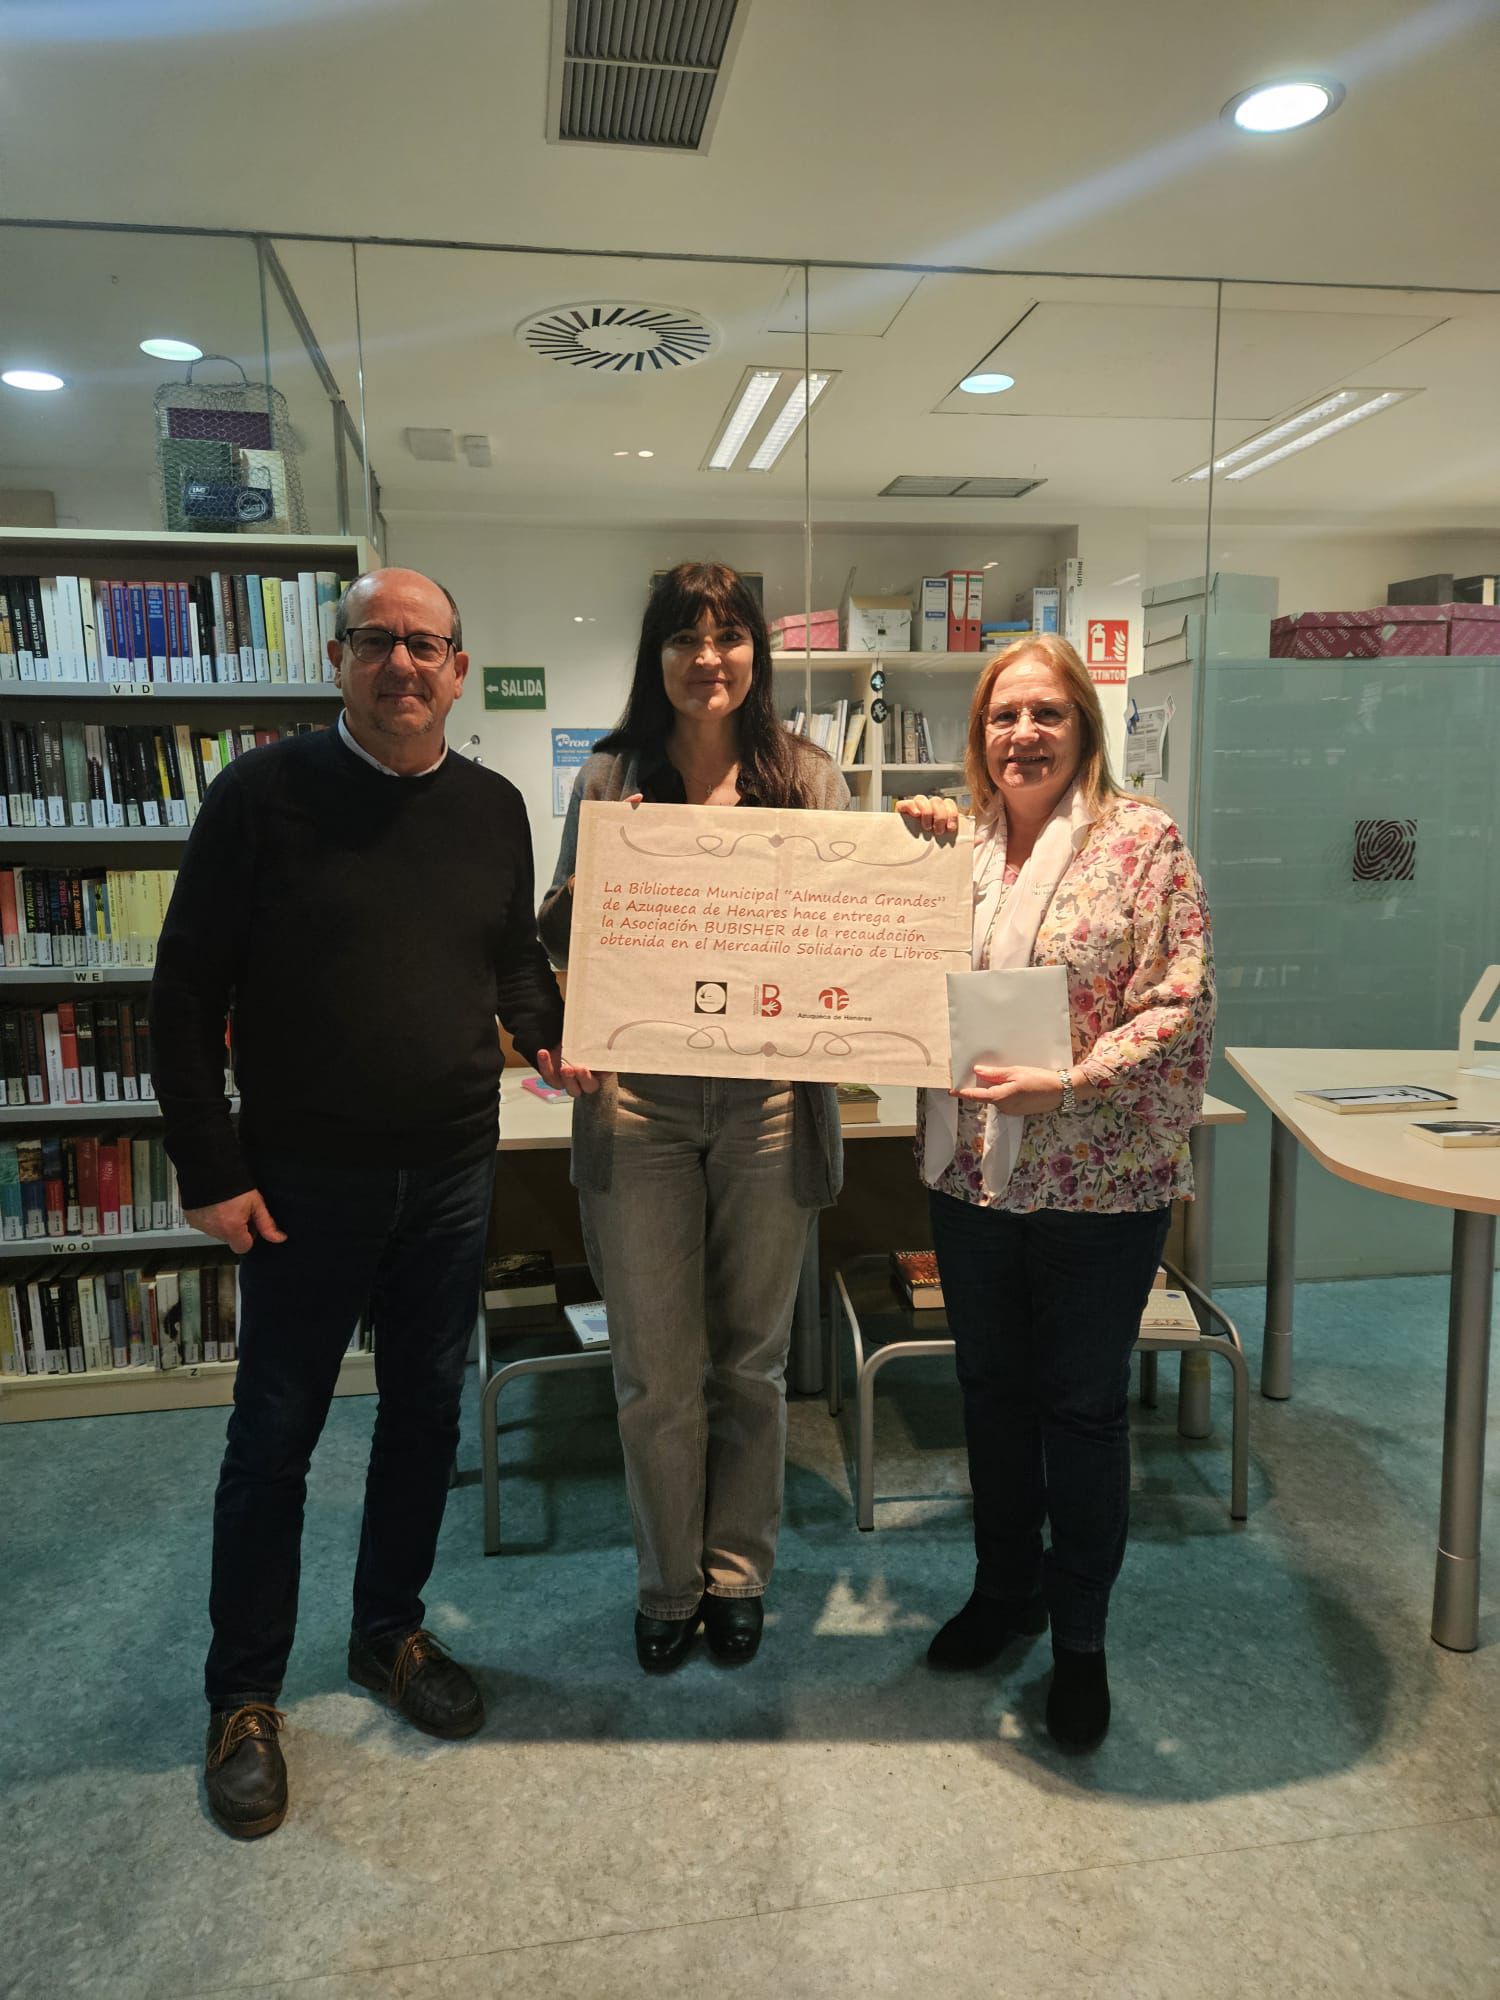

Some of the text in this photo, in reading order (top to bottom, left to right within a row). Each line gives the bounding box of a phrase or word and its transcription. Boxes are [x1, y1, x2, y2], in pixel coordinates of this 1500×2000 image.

[501, 679, 544, 697] SALIDA
[604, 881, 622, 894] La
[629, 882, 700, 897] Biblioteca
[706, 887, 779, 904] Municipal
[602, 898, 906, 927] de Azuqueca de Henares hace entrega a
[601, 915, 926, 942] la Asociación BUBISHER de la recaudación
[600, 933, 942, 961] obtenida en el Mercadillo Solidario de Libros.
[52, 1242, 90, 1252] WOO
[190, 1367, 198, 1376] Z
